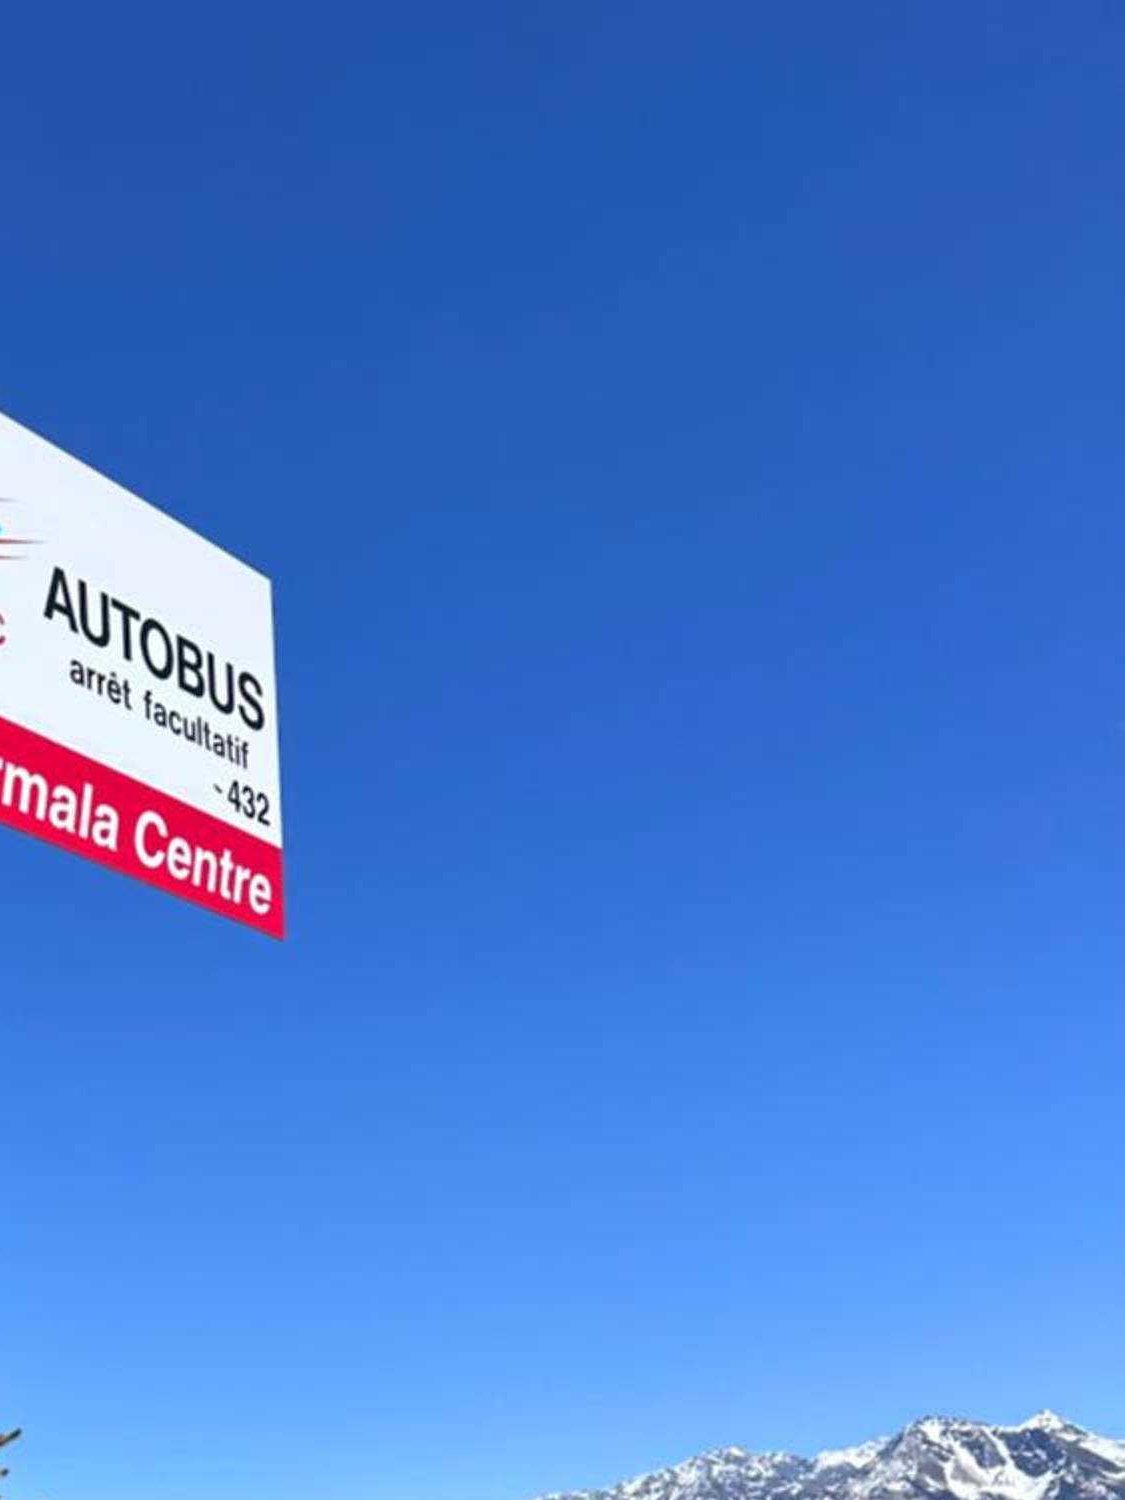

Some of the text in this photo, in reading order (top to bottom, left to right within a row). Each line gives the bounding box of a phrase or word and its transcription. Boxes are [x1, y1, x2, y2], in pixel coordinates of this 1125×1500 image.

[43, 565, 266, 732] AUTOBUS
[69, 658, 250, 770] arrêt facultatif
[134, 809, 273, 916] Centre
